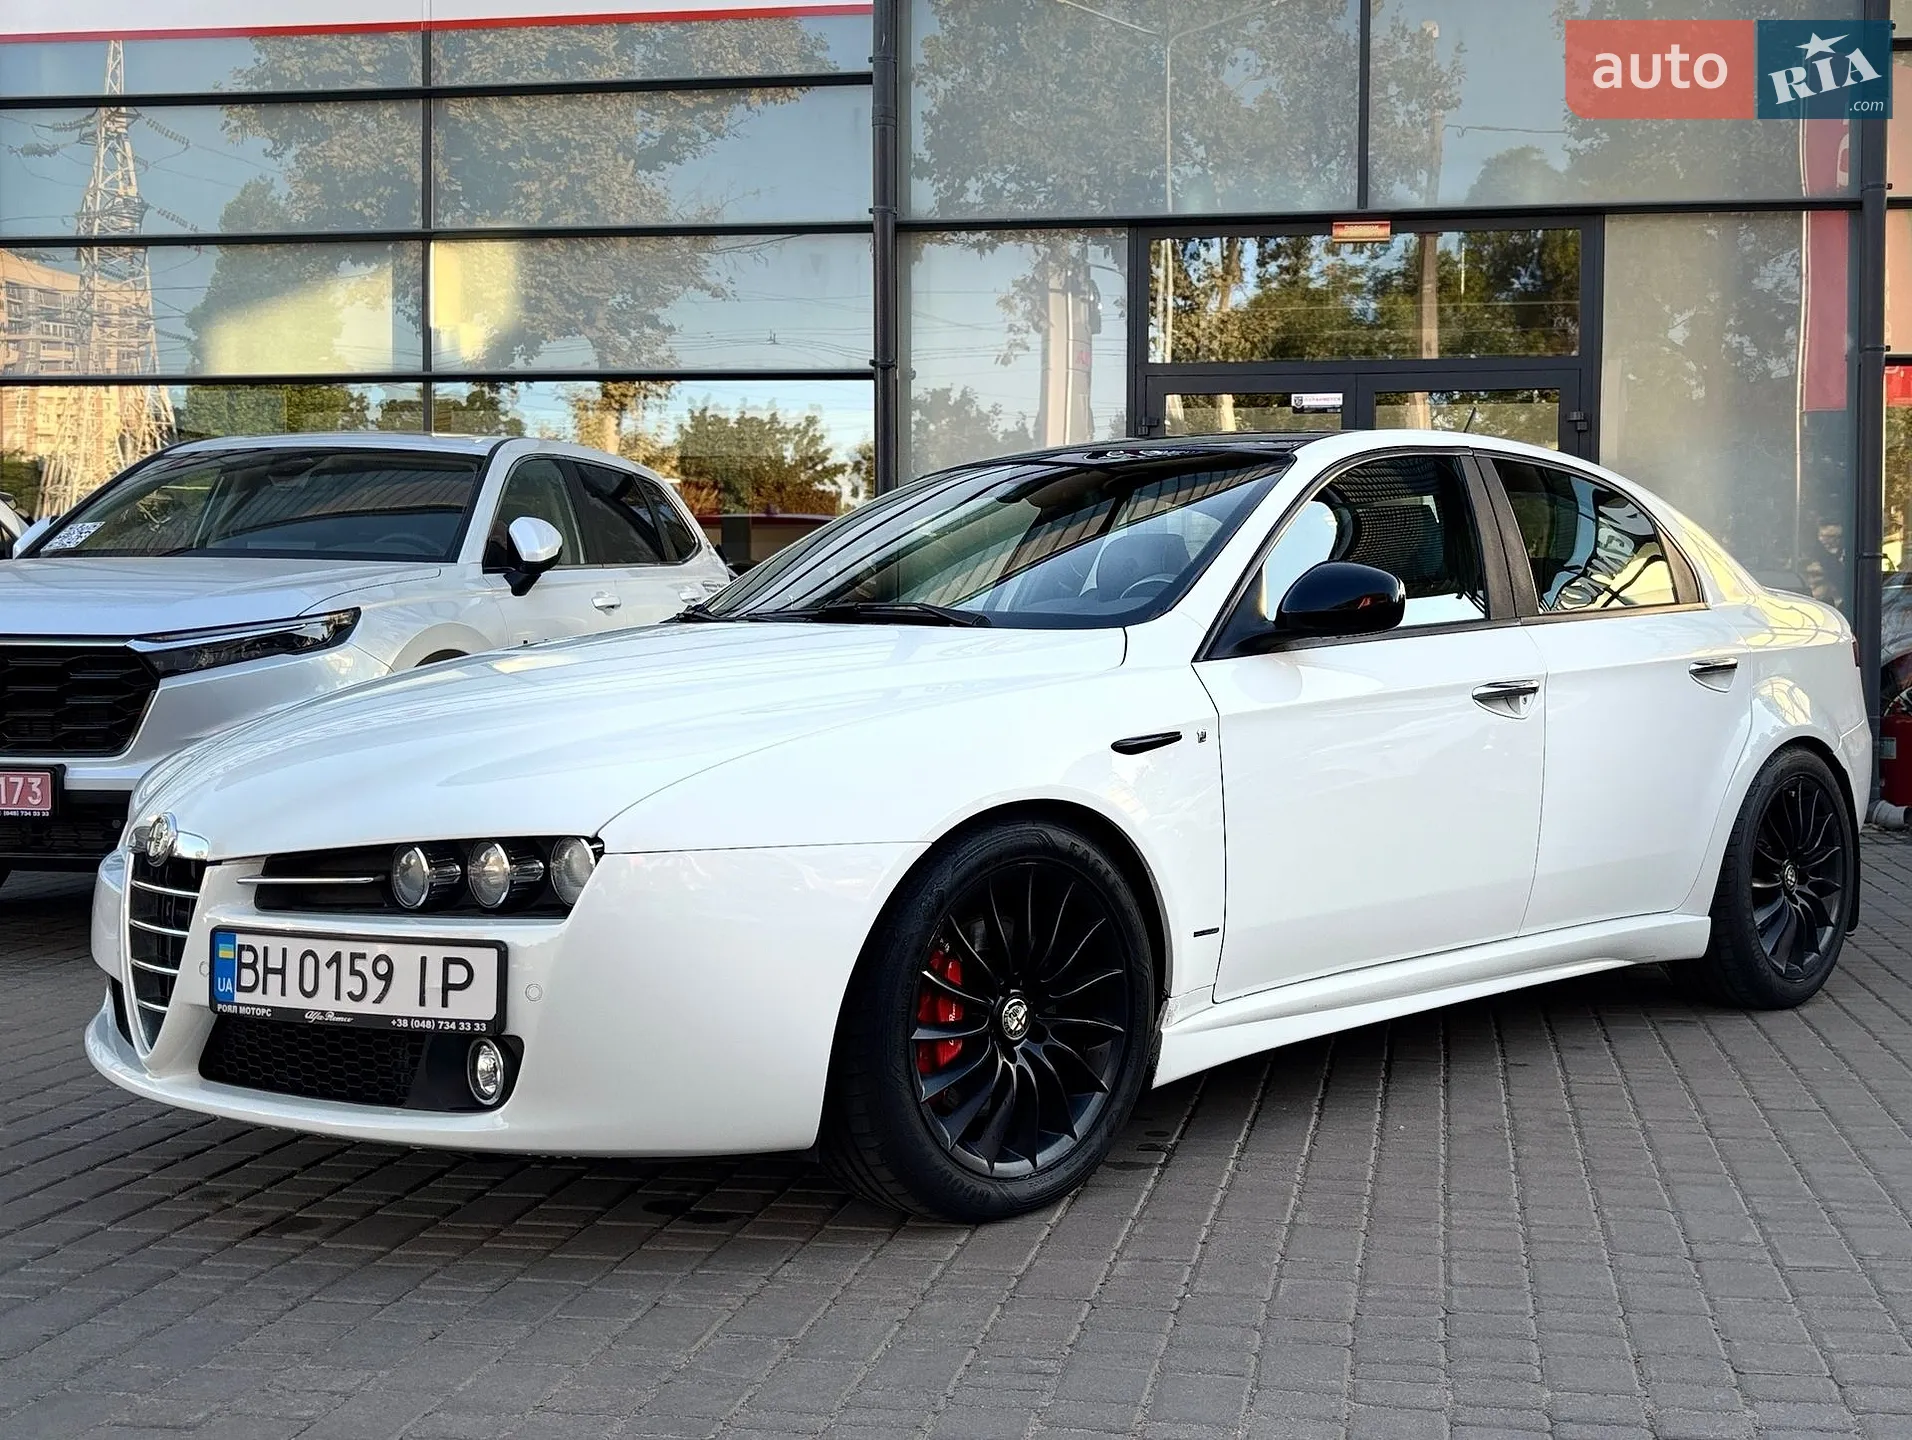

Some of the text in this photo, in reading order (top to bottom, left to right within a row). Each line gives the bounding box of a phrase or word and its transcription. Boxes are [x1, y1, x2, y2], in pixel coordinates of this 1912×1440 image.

[0, 776, 42, 805] 173
[235, 943, 475, 1008] BH 0159 IP
[217, 977, 233, 992] UA
[239, 1006, 272, 1017] МОТОРС
[391, 1018, 487, 1032] +38 (048) 734 33 33
